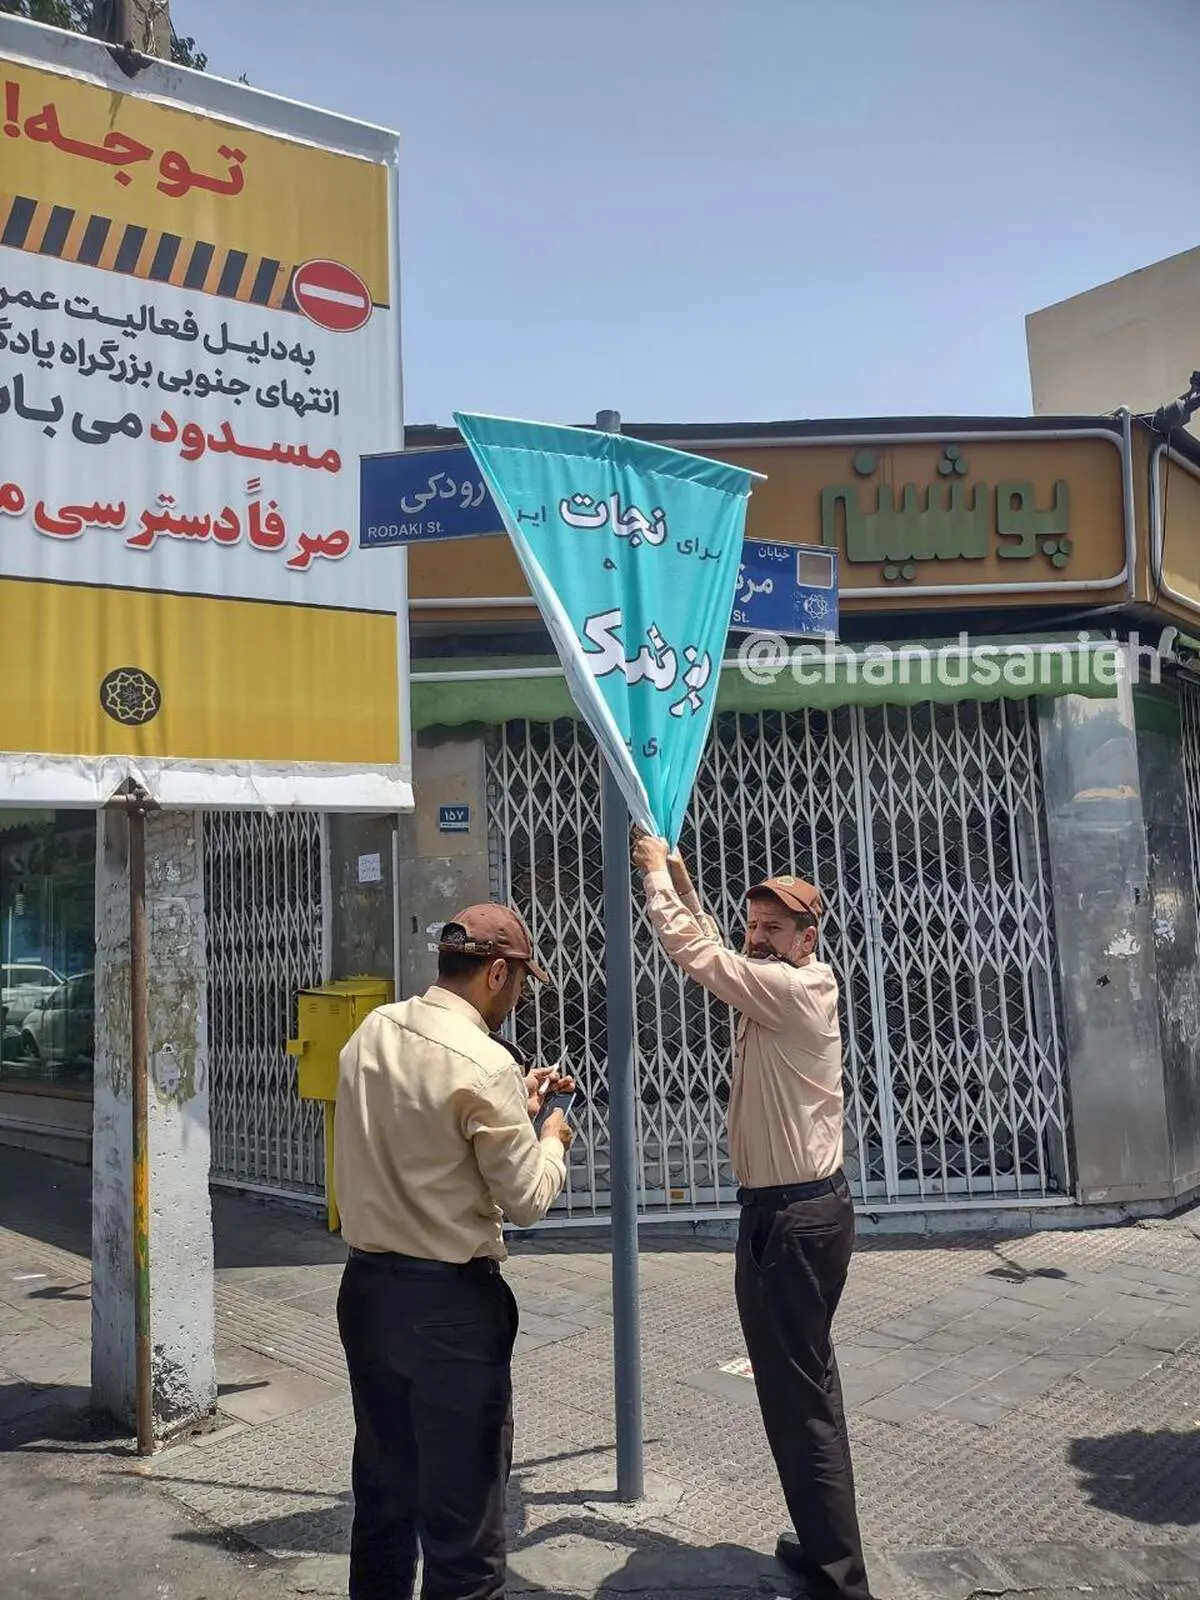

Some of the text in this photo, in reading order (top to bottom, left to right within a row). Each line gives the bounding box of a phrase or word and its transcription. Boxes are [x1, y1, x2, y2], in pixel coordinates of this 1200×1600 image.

[64, 295, 200, 342] فعالیت
[59, 337, 153, 388] بزرگراه
[156, 367, 251, 406] جنوبی
[255, 379, 340, 418] انتهای
[71, 411, 144, 446] می
[149, 410, 342, 473] مسدود
[400, 471, 486, 514] رودکی
[33, 492, 242, 549] دسترسی
[367, 520, 445, 538] RODAKI St.
[558, 491, 669, 548] نجات
[676, 536, 723, 564] برای
[758, 545, 791, 562] خیابان
